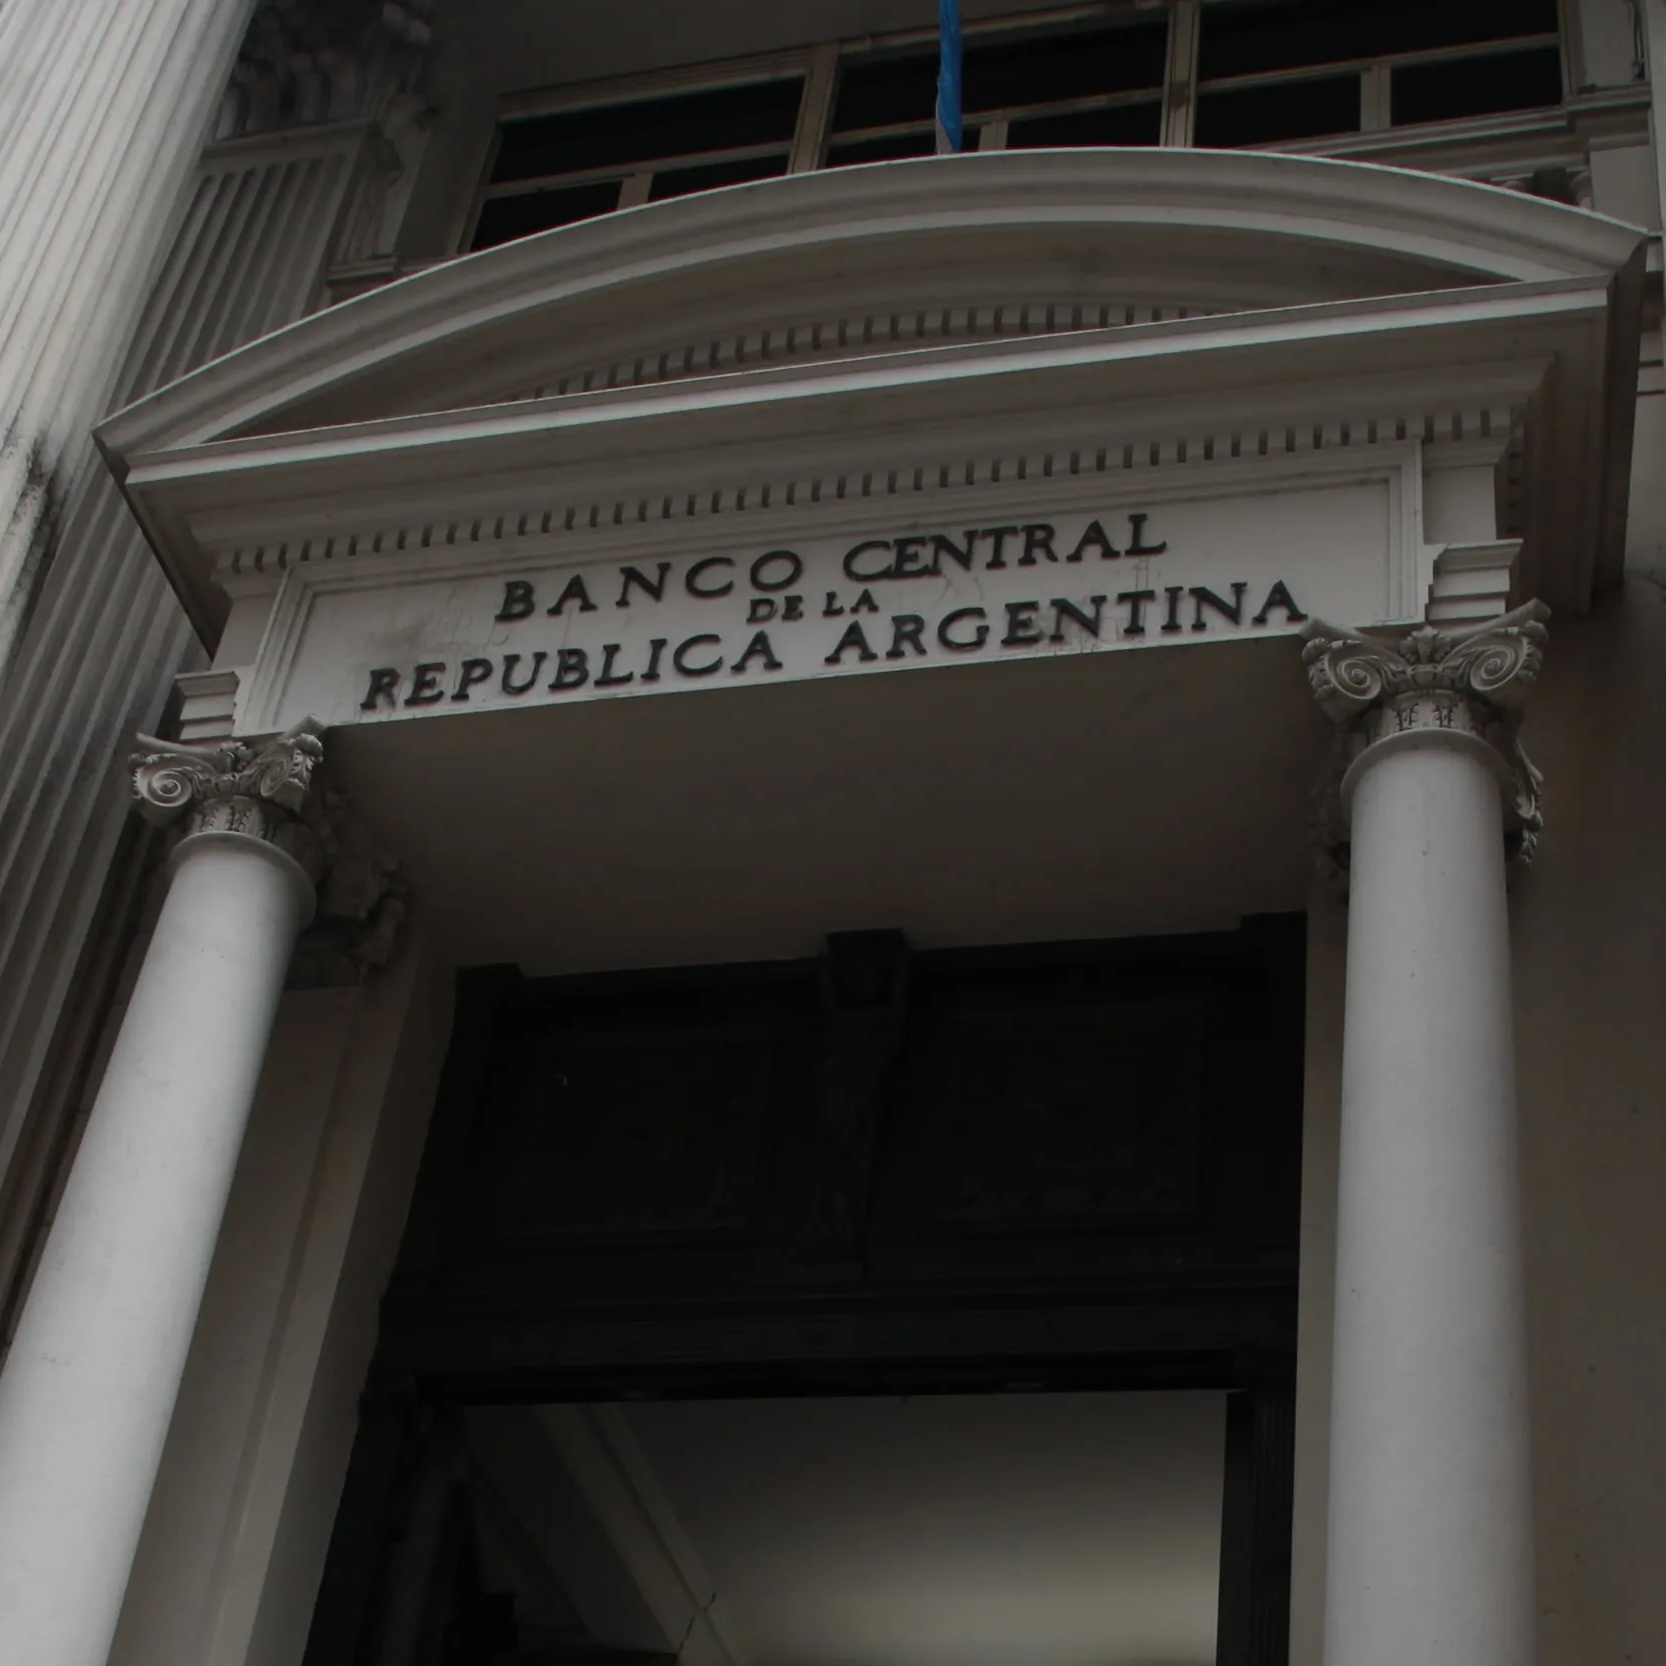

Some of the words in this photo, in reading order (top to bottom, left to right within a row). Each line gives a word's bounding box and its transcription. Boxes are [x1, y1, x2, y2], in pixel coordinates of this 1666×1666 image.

[495, 551, 803, 622] BANCO
[843, 514, 1168, 582] CENTRAL
[746, 595, 804, 624] DE
[823, 588, 879, 617] LA
[360, 630, 783, 710] REPUBLICA
[824, 579, 1309, 664] ARGENTINA
